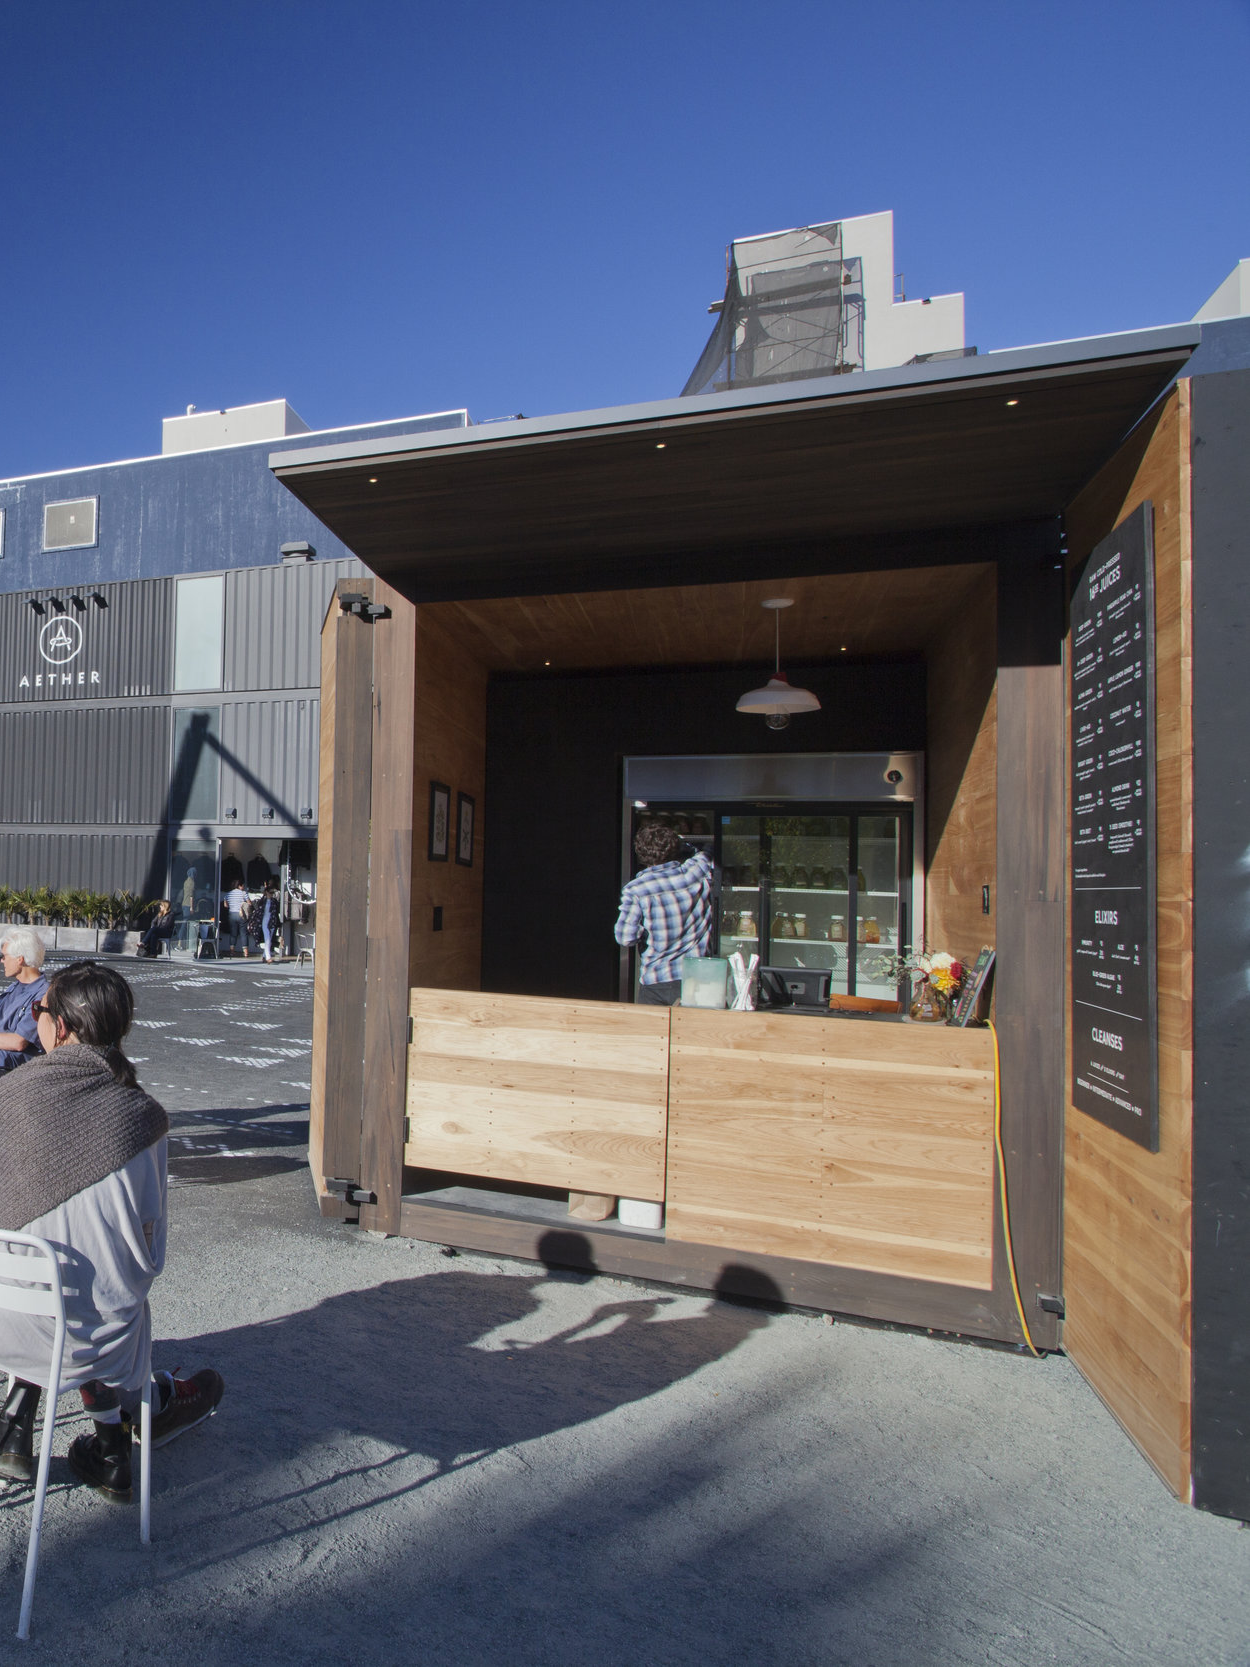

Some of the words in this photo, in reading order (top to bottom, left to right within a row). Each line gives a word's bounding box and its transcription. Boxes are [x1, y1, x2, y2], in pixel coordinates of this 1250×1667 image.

[1100, 565, 1121, 593] JUICES
[19, 671, 100, 687] AETHER
[1094, 910, 1118, 926] ELIXIRS
[1091, 1026, 1124, 1052] CLEANSES
